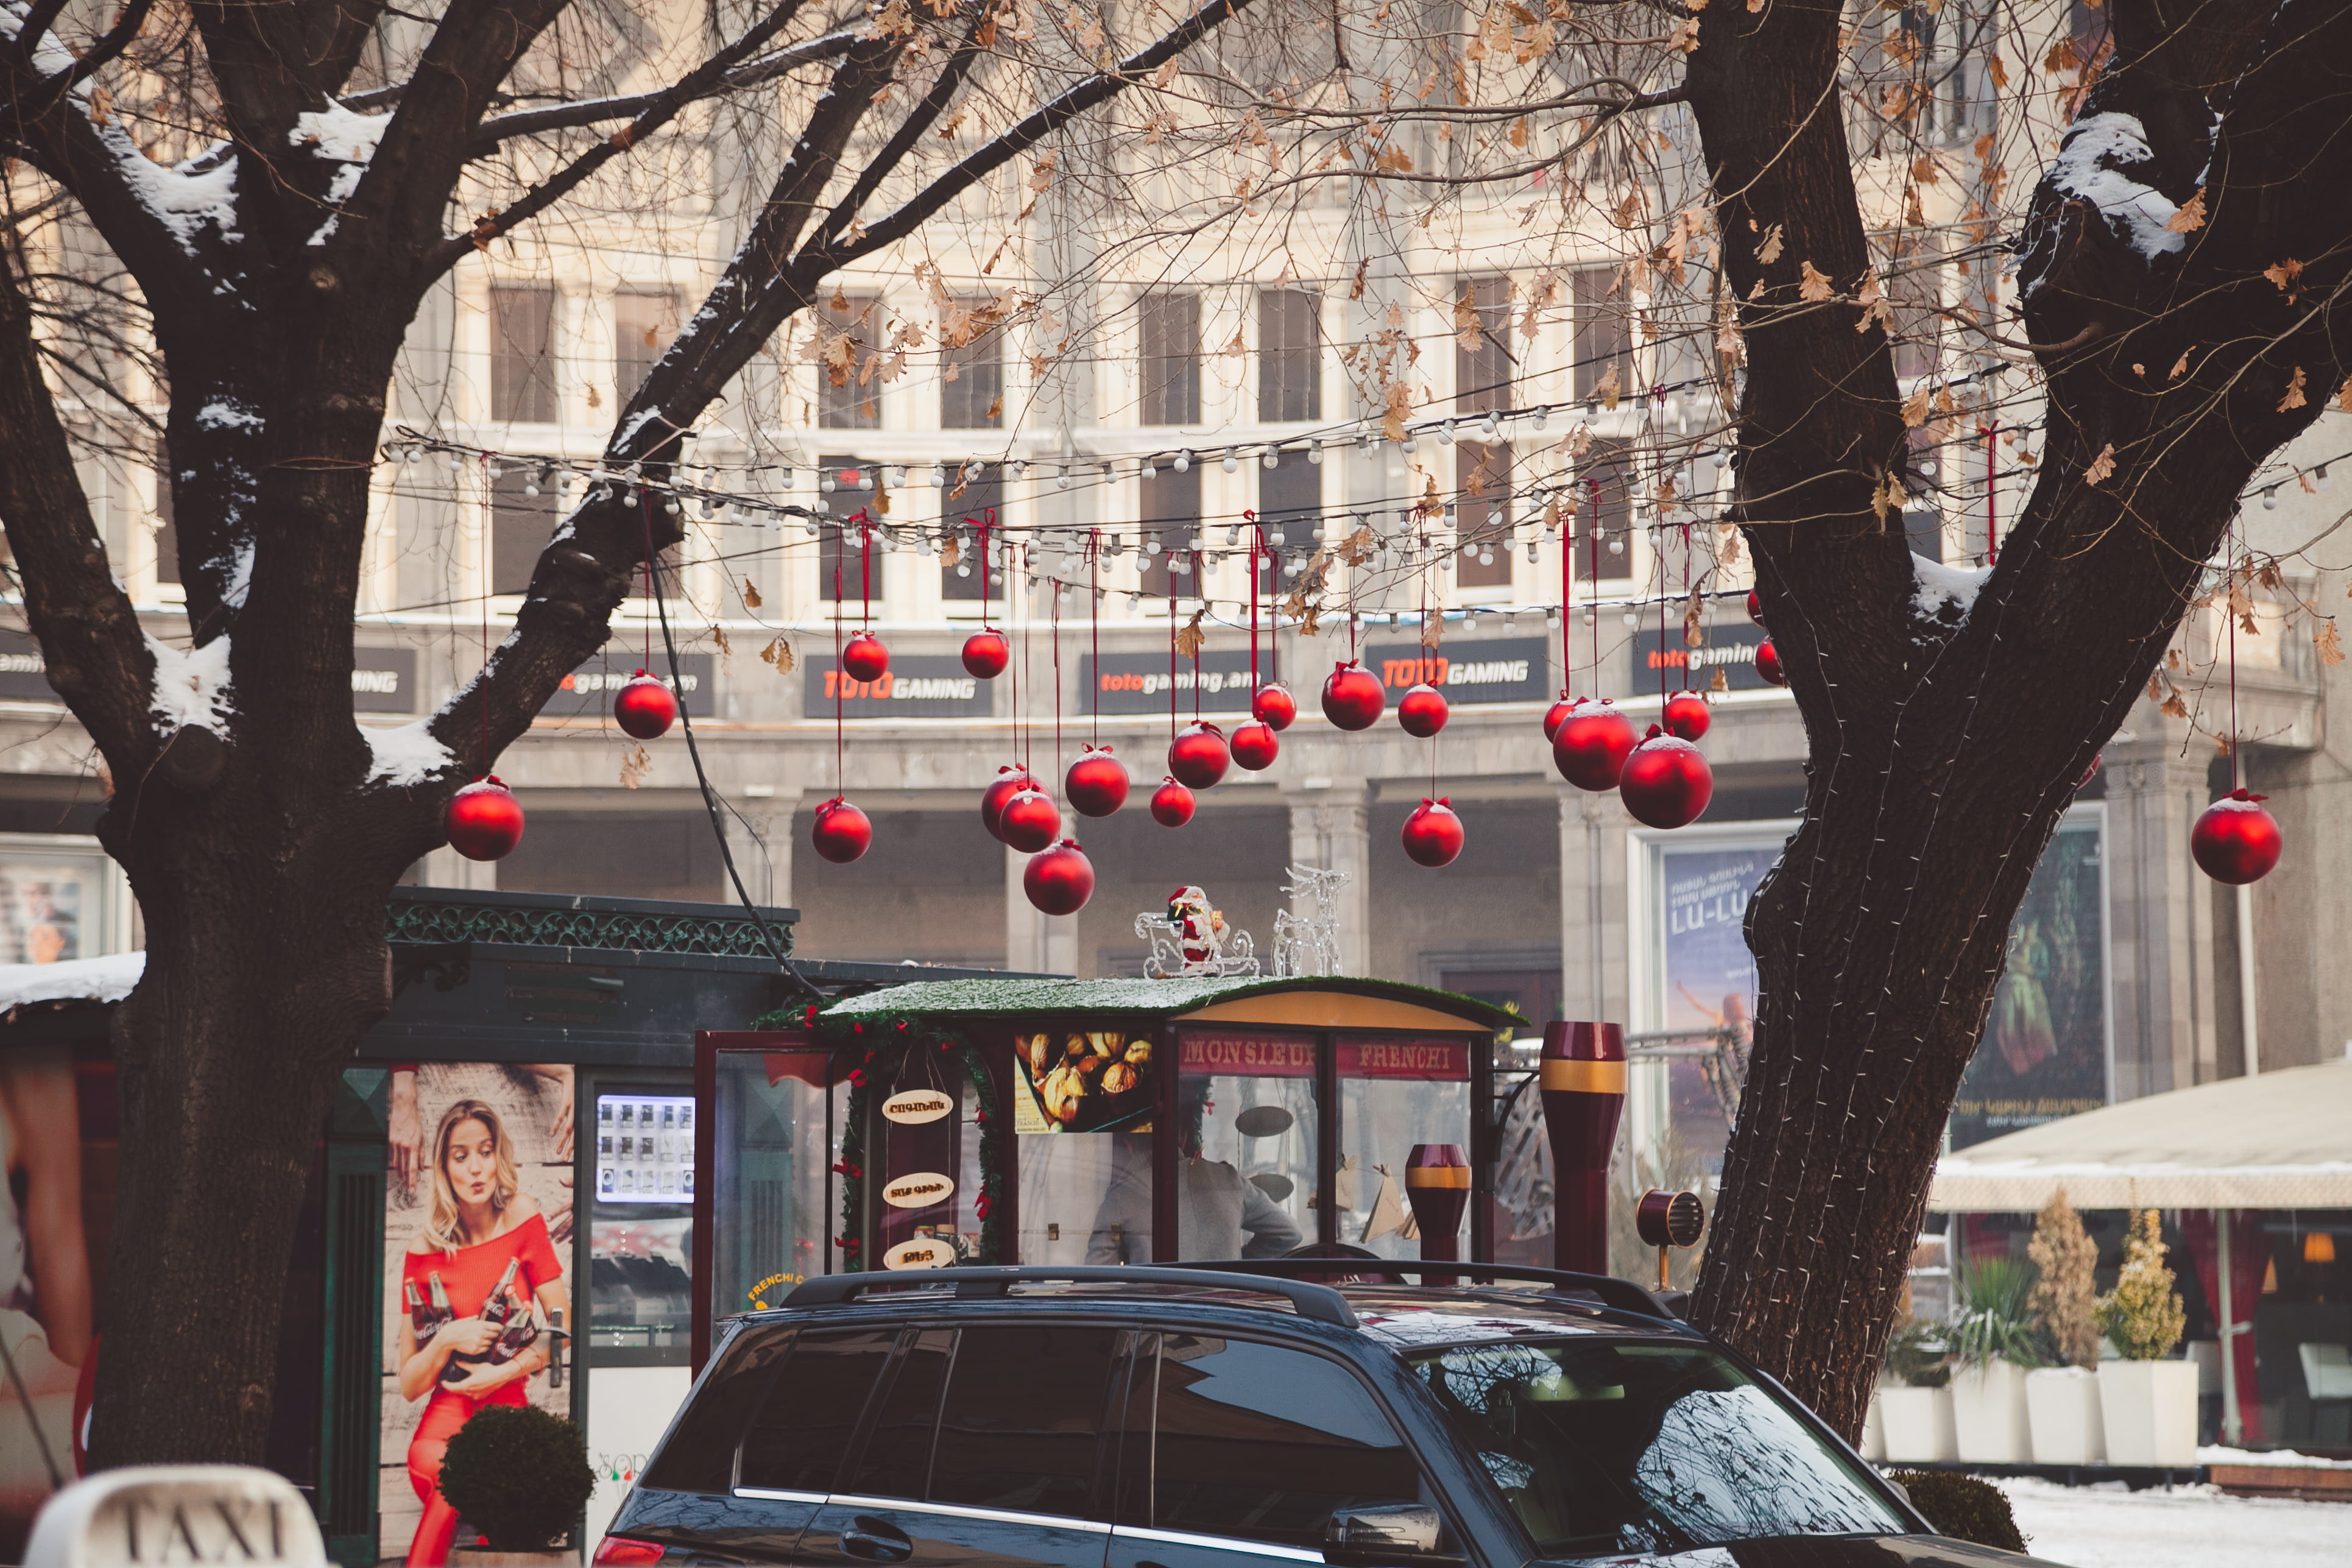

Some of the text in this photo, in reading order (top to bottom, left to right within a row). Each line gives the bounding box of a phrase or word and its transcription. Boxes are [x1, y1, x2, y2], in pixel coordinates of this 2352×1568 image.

[1647, 642, 1759, 671] totogamin
[1358, 1044, 1450, 1070] FRENCHI
[747, 1273, 794, 1301] FRENCHI
[111, 1496, 291, 1562] TAXI
